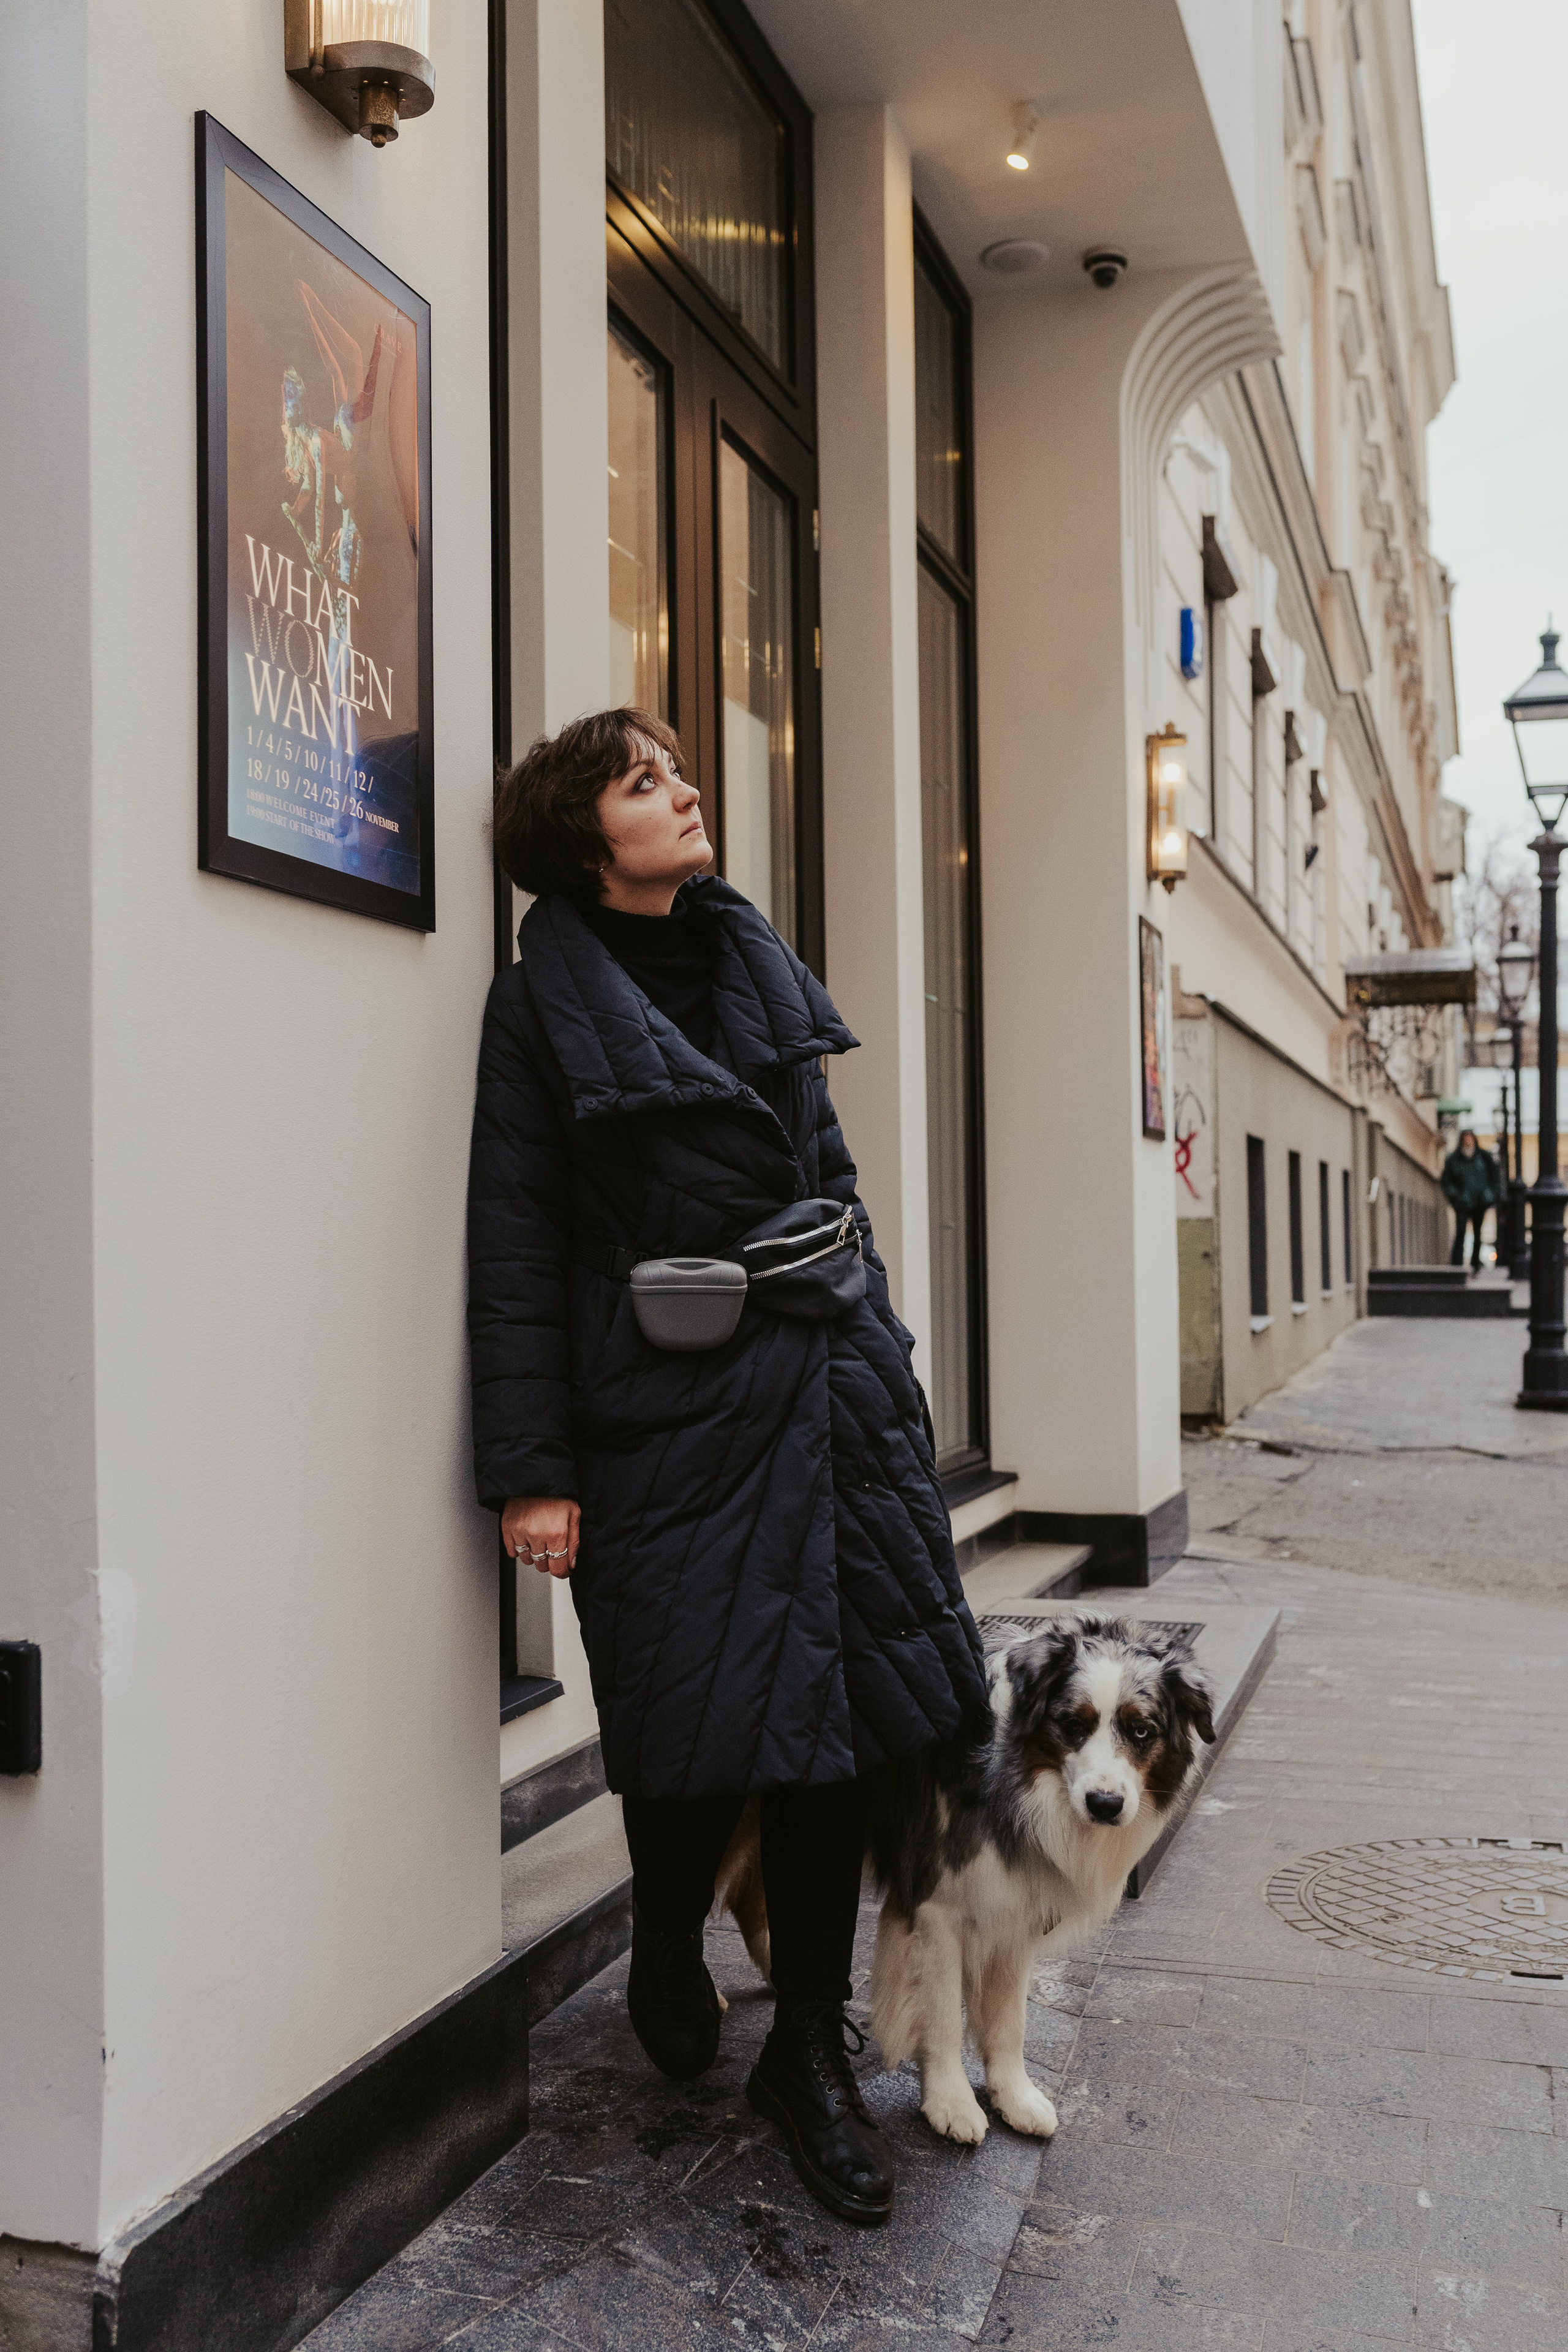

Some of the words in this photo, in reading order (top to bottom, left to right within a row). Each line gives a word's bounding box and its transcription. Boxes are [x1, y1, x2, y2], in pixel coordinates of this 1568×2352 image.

[245, 534, 360, 647] WHAT
[245, 594, 394, 720] WOMEN
[244, 652, 360, 756] WANT
[265, 794, 308, 820] WELCOME
[309, 810, 336, 829] EVENT
[265, 811, 288, 827] START
[289, 820, 300, 832] OF
[300, 823, 314, 837] THE
[314, 828, 335, 844] SHOW
[365, 811, 399, 833] NOVEMBER
